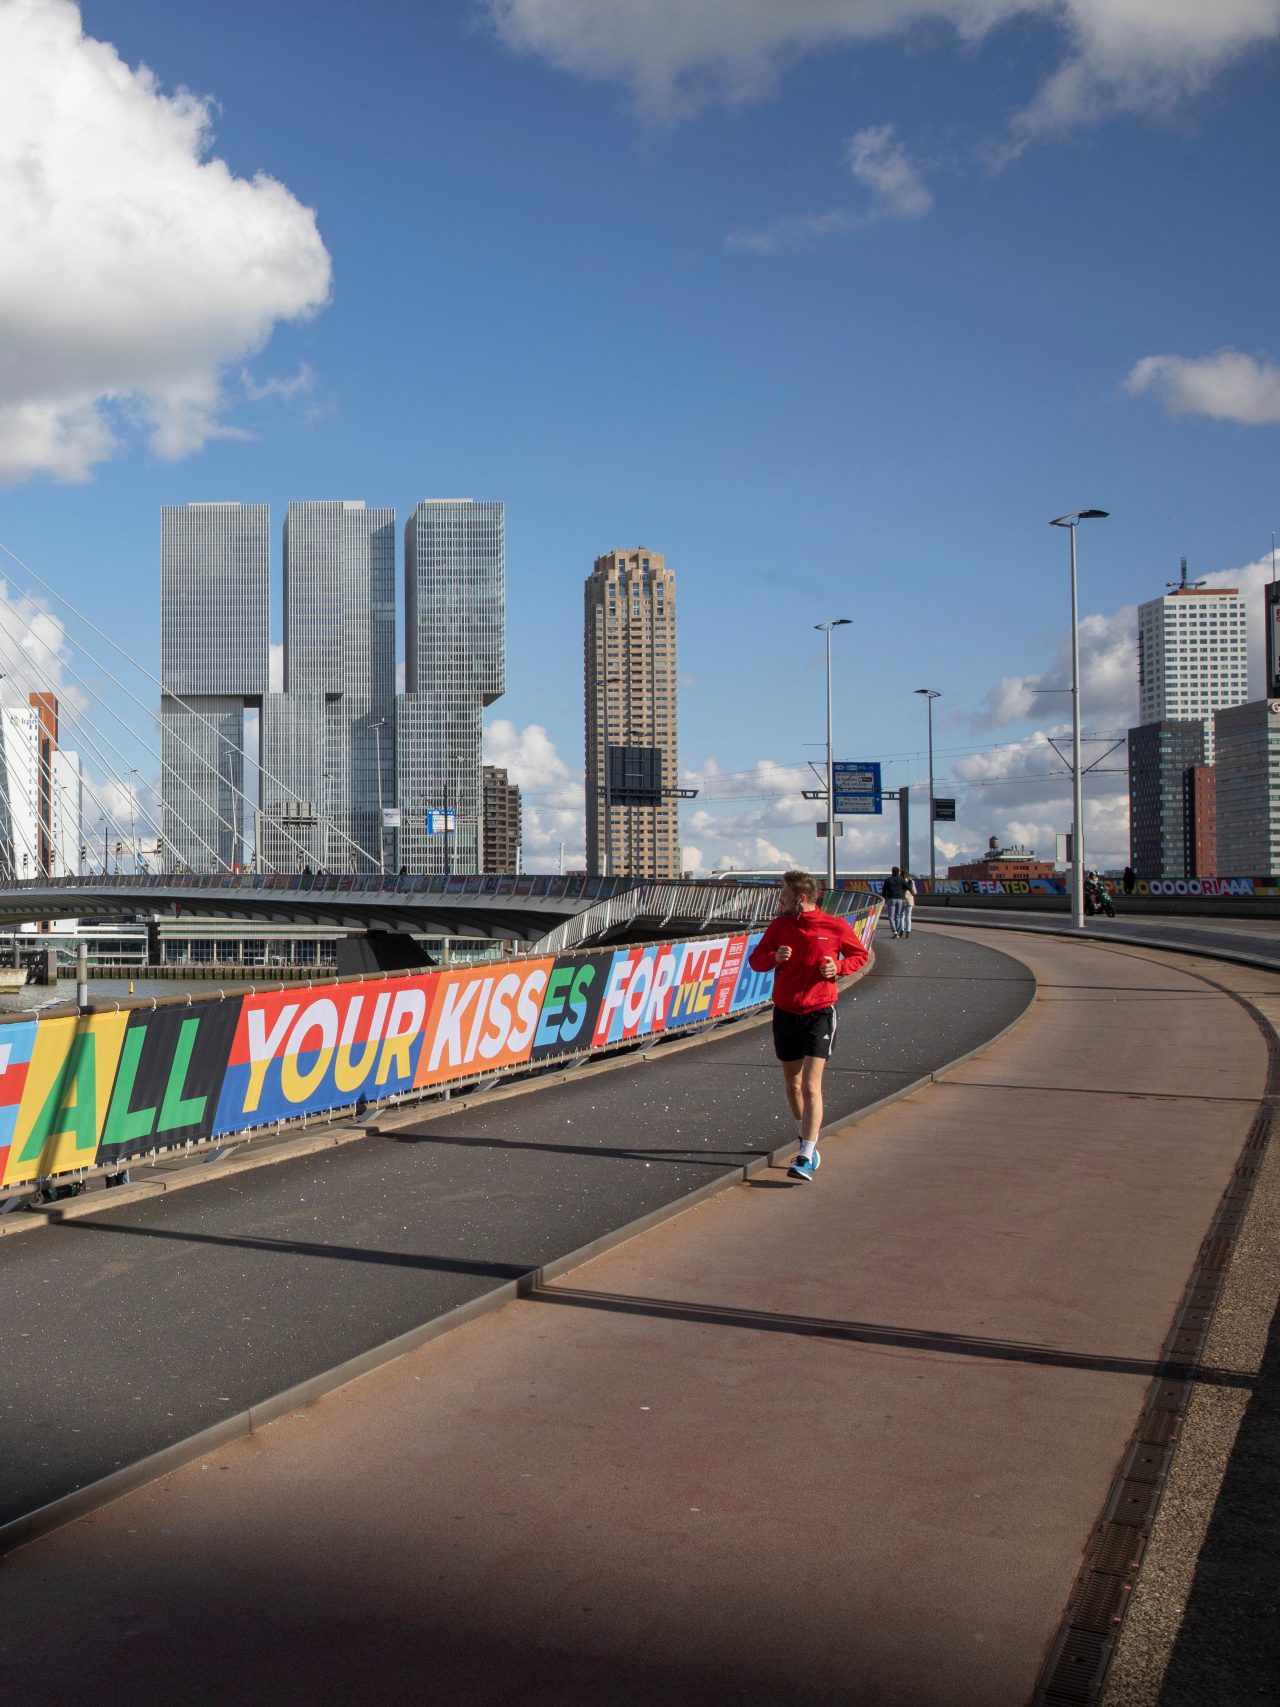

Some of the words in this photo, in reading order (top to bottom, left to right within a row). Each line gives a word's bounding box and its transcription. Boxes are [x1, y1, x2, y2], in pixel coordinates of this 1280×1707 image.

[961, 880, 1030, 894] DEFEATED
[18, 1018, 208, 1162] ALL
[242, 989, 425, 1113] YOUR
[428, 964, 595, 1072] KISSES
[598, 953, 676, 1035] FOR
[671, 948, 720, 1017] ME
